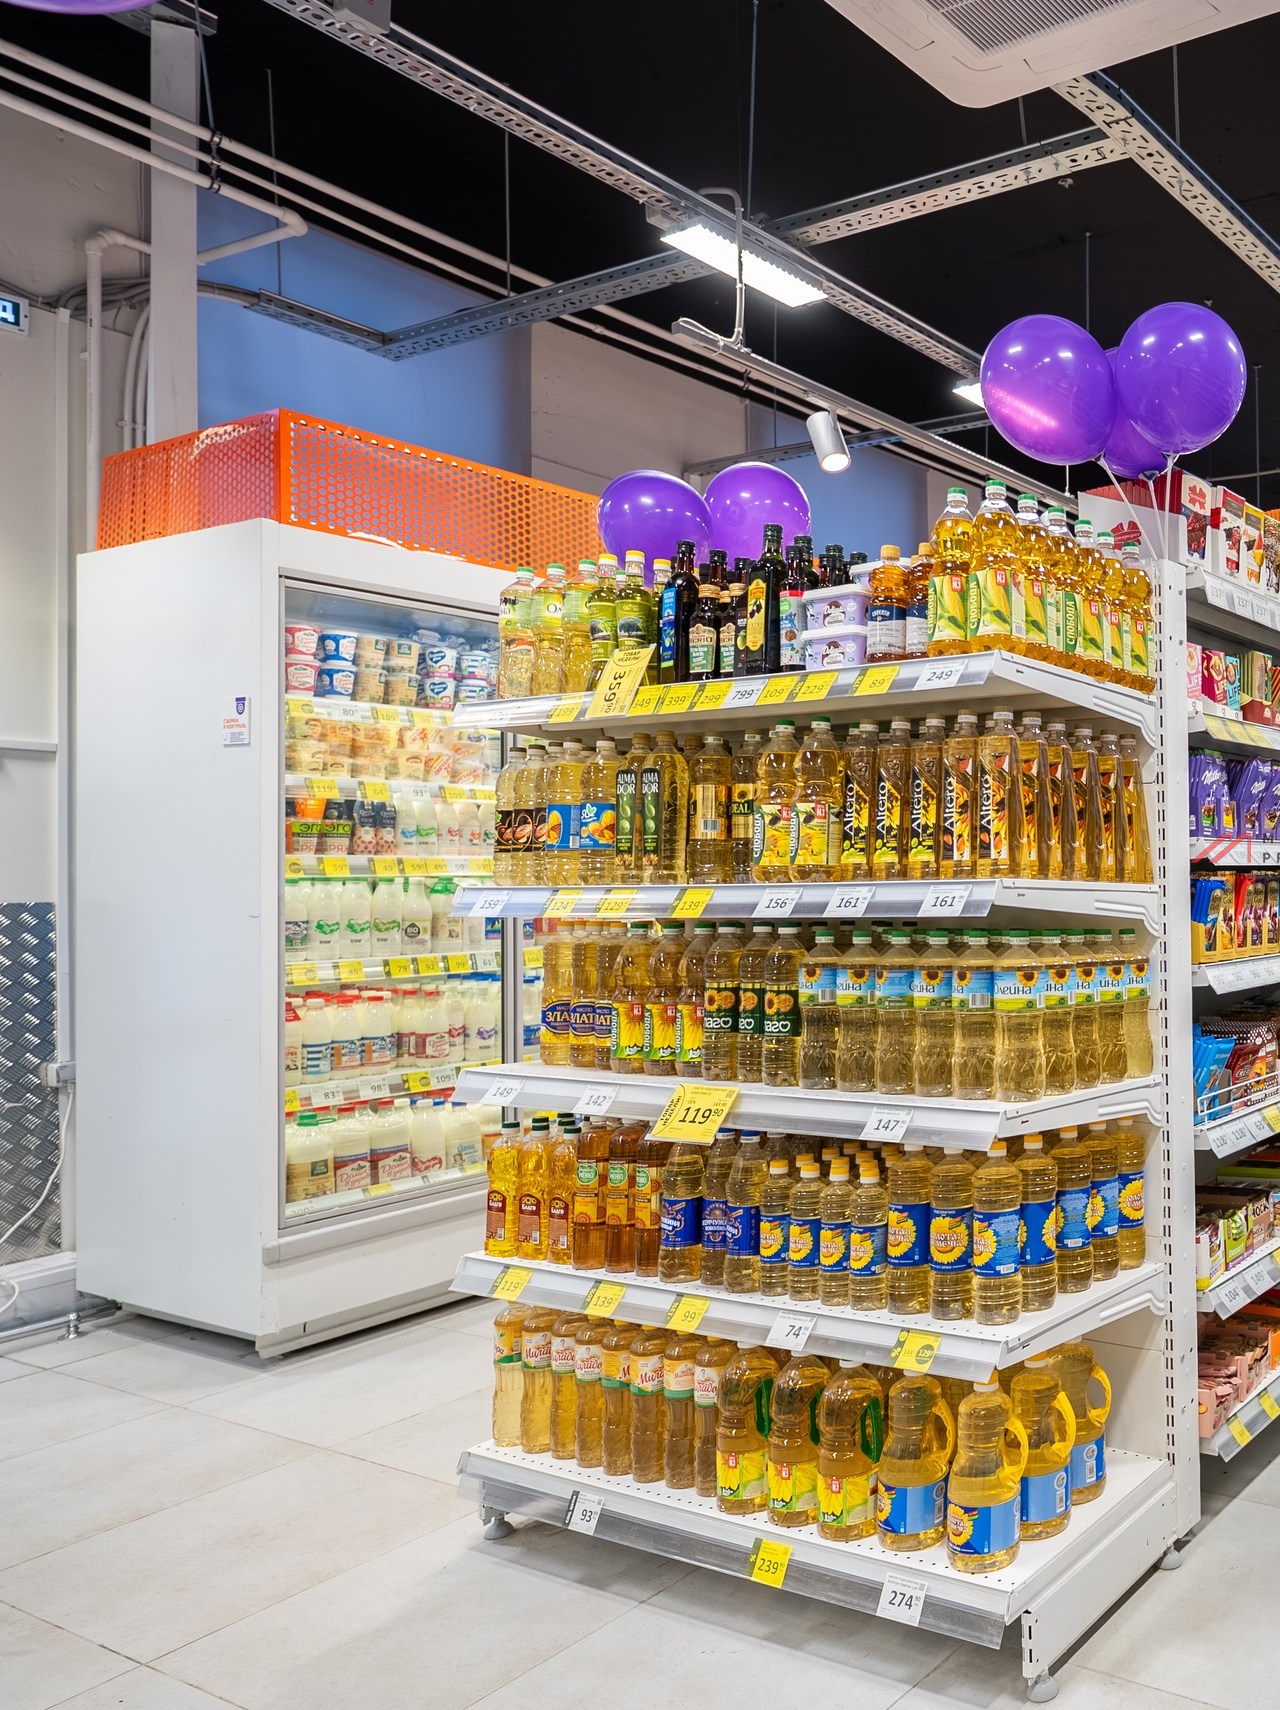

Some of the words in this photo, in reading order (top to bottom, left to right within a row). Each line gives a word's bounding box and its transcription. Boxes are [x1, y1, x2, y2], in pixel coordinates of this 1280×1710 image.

[926, 670, 953, 682] 249
[732, 690, 754, 701] 799
[617, 772, 636, 783] ALMA
[643, 772, 659, 783] ALMA
[413, 789, 424, 797] 93
[617, 784, 635, 794] DOR
[642, 783, 659, 794] DOR
[844, 783, 855, 836] Altero
[877, 781, 887, 835] Altero
[911, 780, 922, 833] Altero
[765, 898, 787, 908] 156
[836, 897, 859, 908] 161
[931, 895, 956, 908] 161
[436, 1075, 451, 1083] 109
[371, 1084, 382, 1092] 98
[324, 1091, 336, 1099] 83
[678, 1106, 712, 1125] 119
[712, 1108, 724, 1118] 90
[873, 1119, 900, 1132] 147
[593, 1297, 612, 1308] 139
[681, 1311, 697, 1322] 99
[785, 1325, 802, 1338] 74
[580, 1508, 593, 1523] 93
[758, 1558, 779, 1575] 239
[888, 1590, 914, 1610] 274
